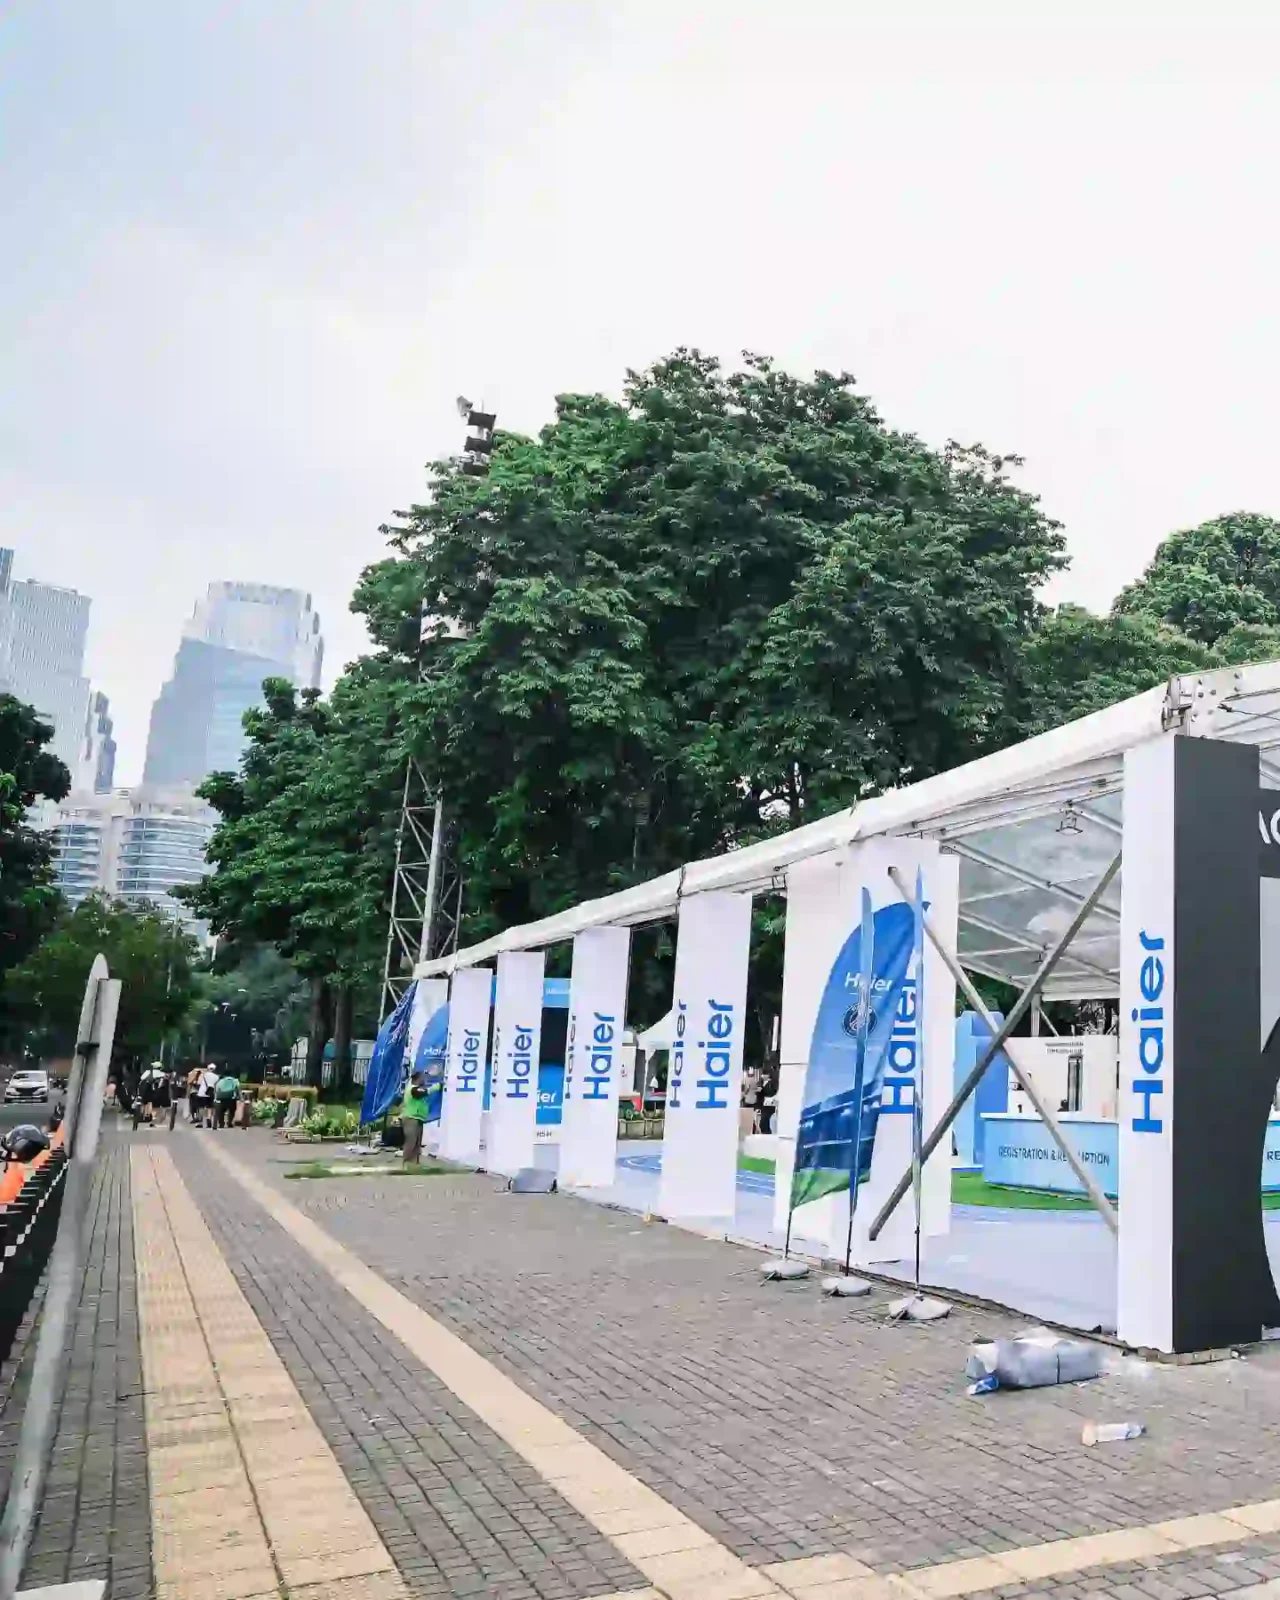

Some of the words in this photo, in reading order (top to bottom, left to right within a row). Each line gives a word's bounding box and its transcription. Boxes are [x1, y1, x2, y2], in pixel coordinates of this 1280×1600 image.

[844, 972, 893, 991] Hier
[456, 1029, 480, 1092] Haier
[506, 1025, 533, 1098] Haier
[583, 1012, 615, 1099] Haier
[695, 999, 733, 1109] Haier
[1131, 929, 1165, 1133] Haier
[999, 1147, 1048, 1160] REGISTRATION
